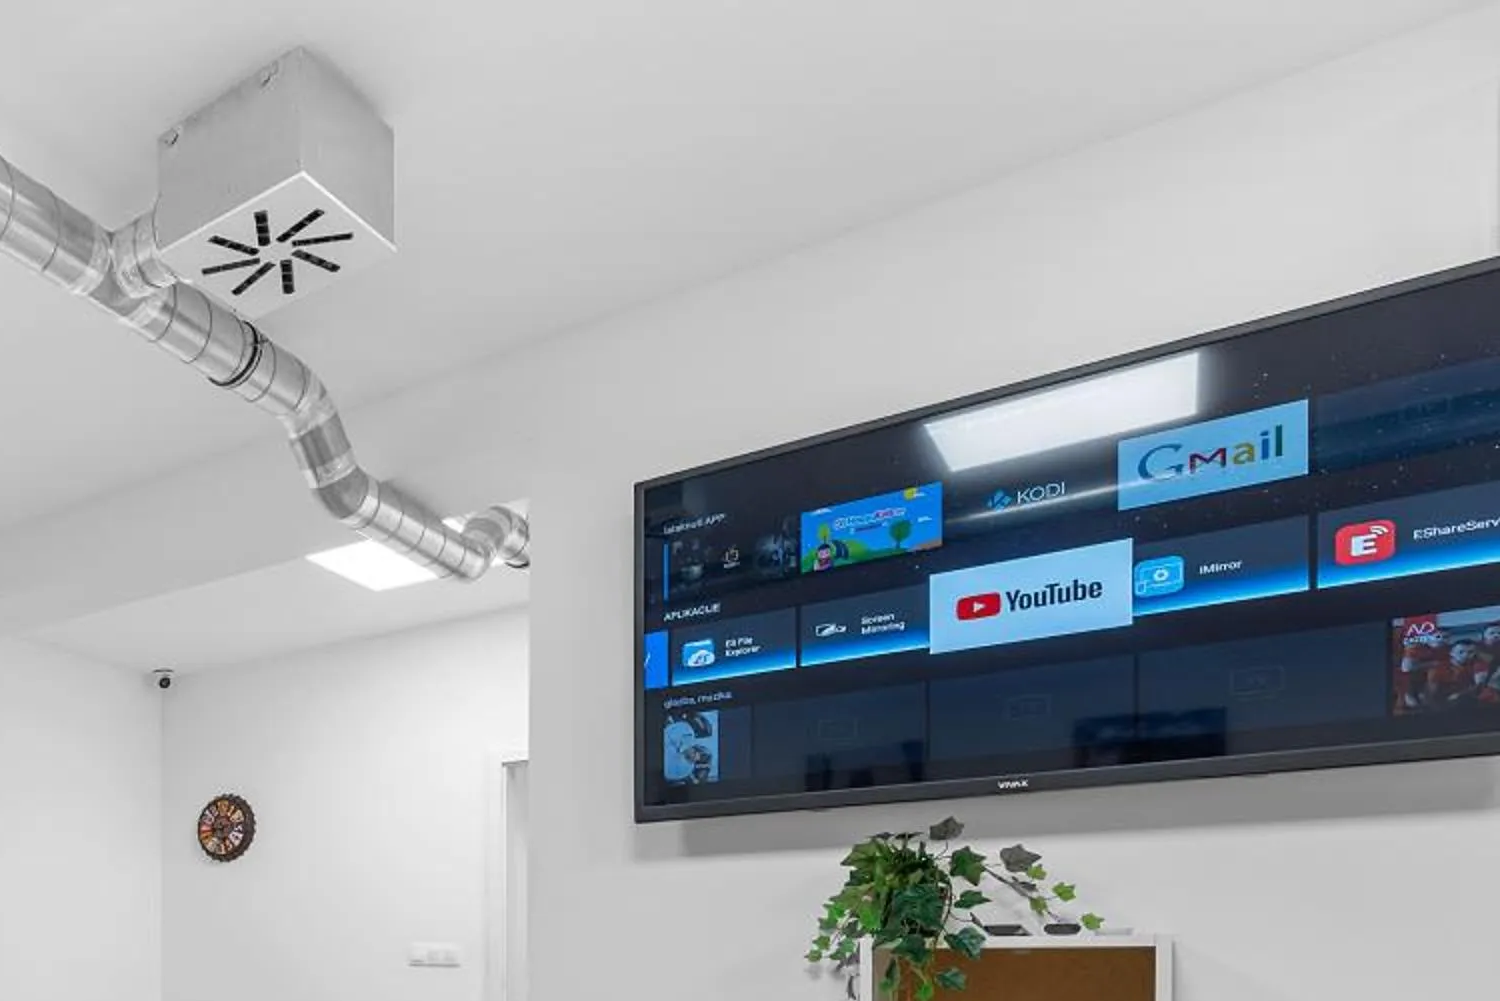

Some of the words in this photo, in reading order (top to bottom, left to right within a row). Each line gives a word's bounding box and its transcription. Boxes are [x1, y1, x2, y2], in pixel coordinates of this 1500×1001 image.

[1137, 423, 1283, 480] Gmail
[1016, 481, 1066, 504] KODI
[1005, 579, 1104, 612] YouTube
[663, 602, 721, 622] APLIKACIJE
